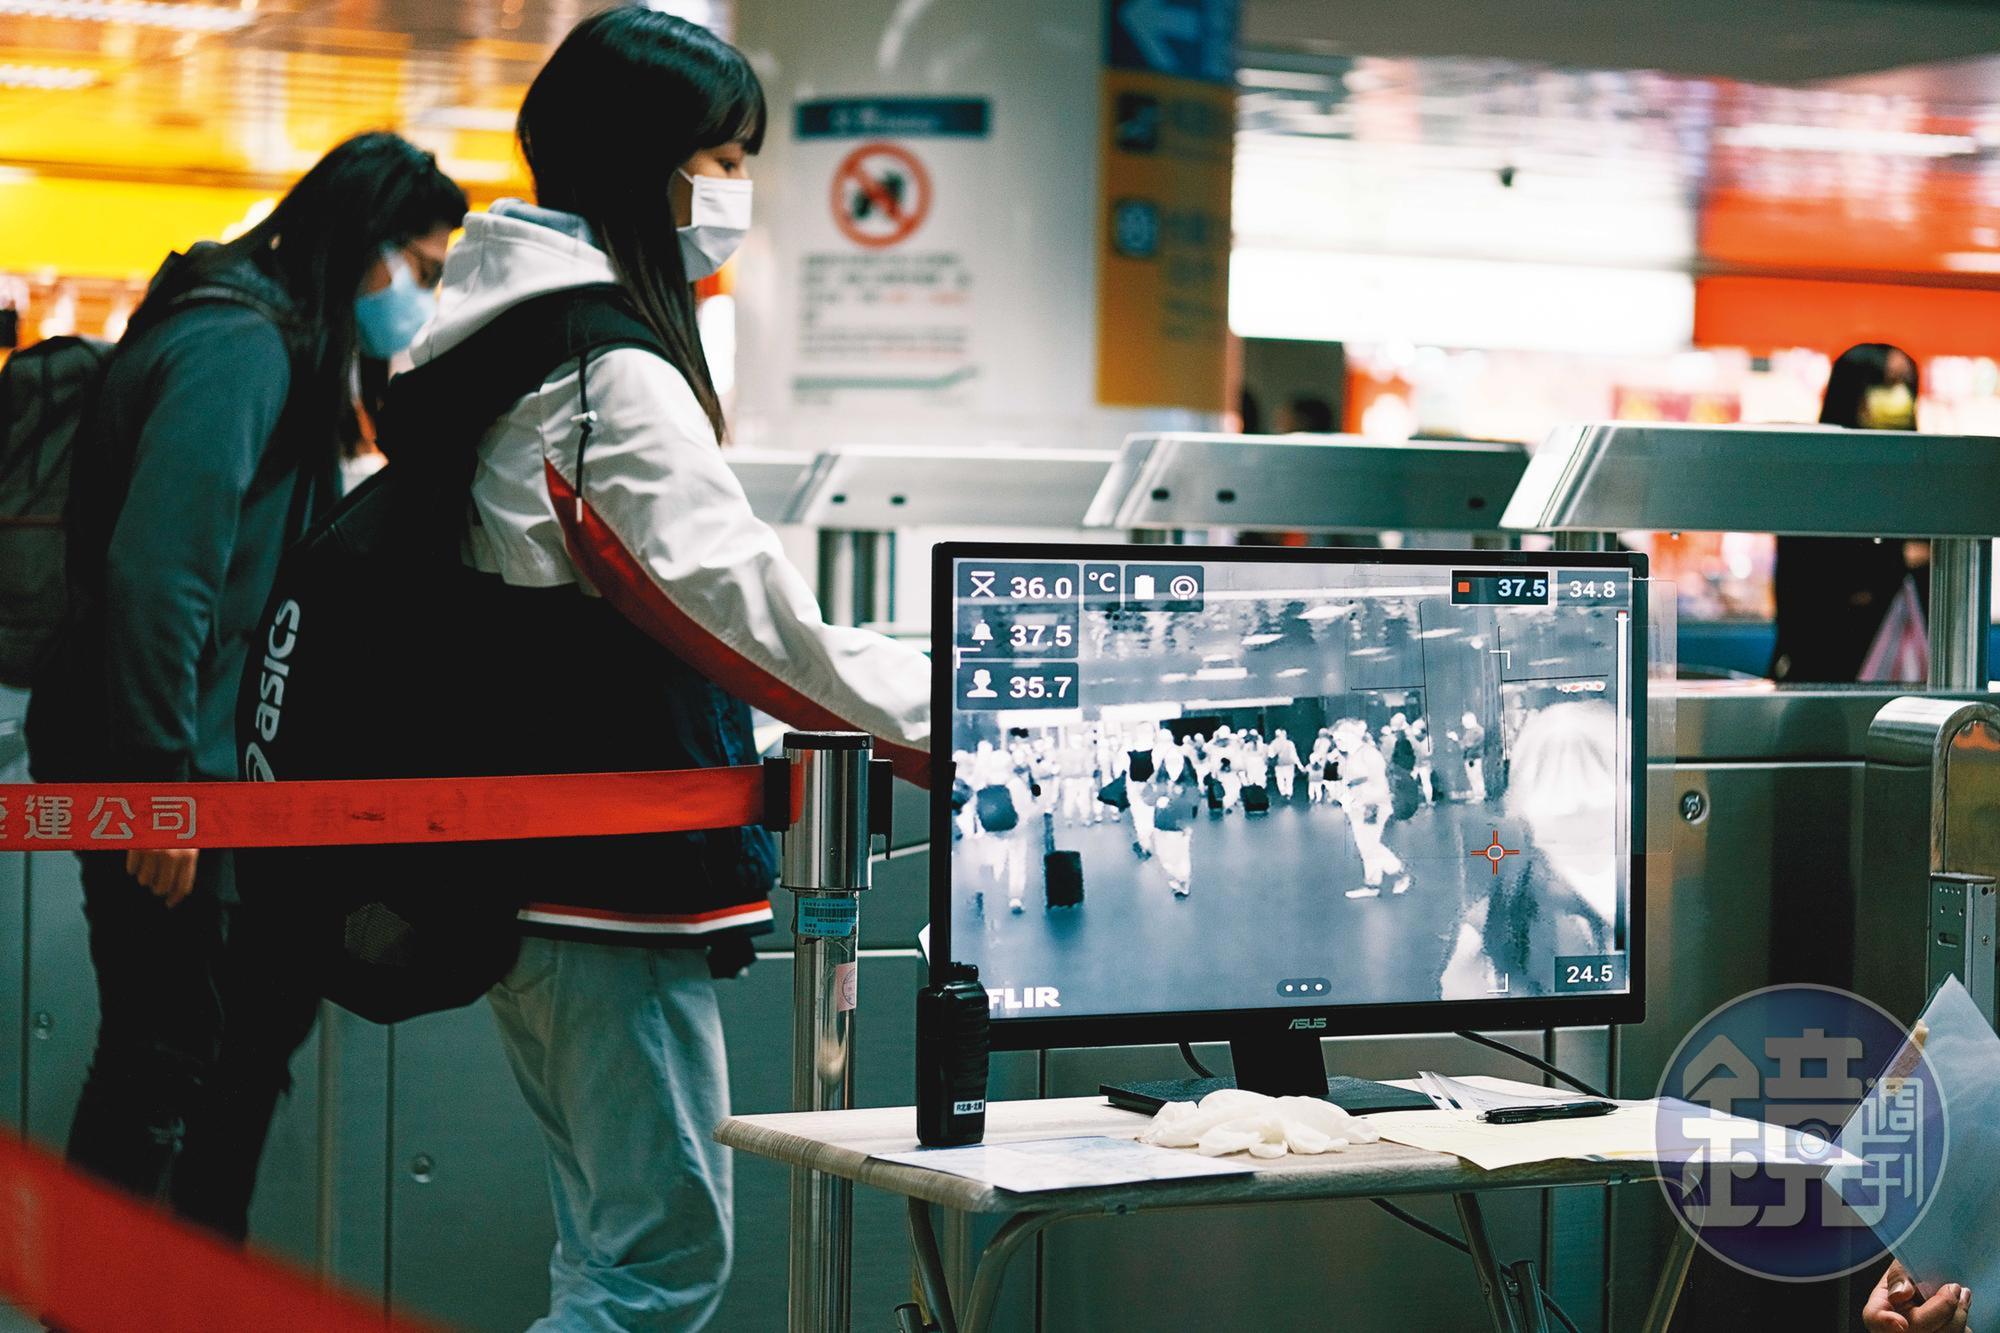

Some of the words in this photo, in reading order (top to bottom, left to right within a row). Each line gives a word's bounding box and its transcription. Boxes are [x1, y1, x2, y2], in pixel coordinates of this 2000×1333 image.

[1010, 576, 1073, 599] 36.0
[1498, 578, 1547, 597] 37.5
[1569, 580, 1616, 598] 34.8
[1009, 624, 1073, 647] 37.5
[1009, 676, 1073, 699] 35.7
[0, 795, 197, 840] 運公司
[1566, 965, 1613, 983] 24.5
[1288, 1018, 1327, 1030] ASUS
